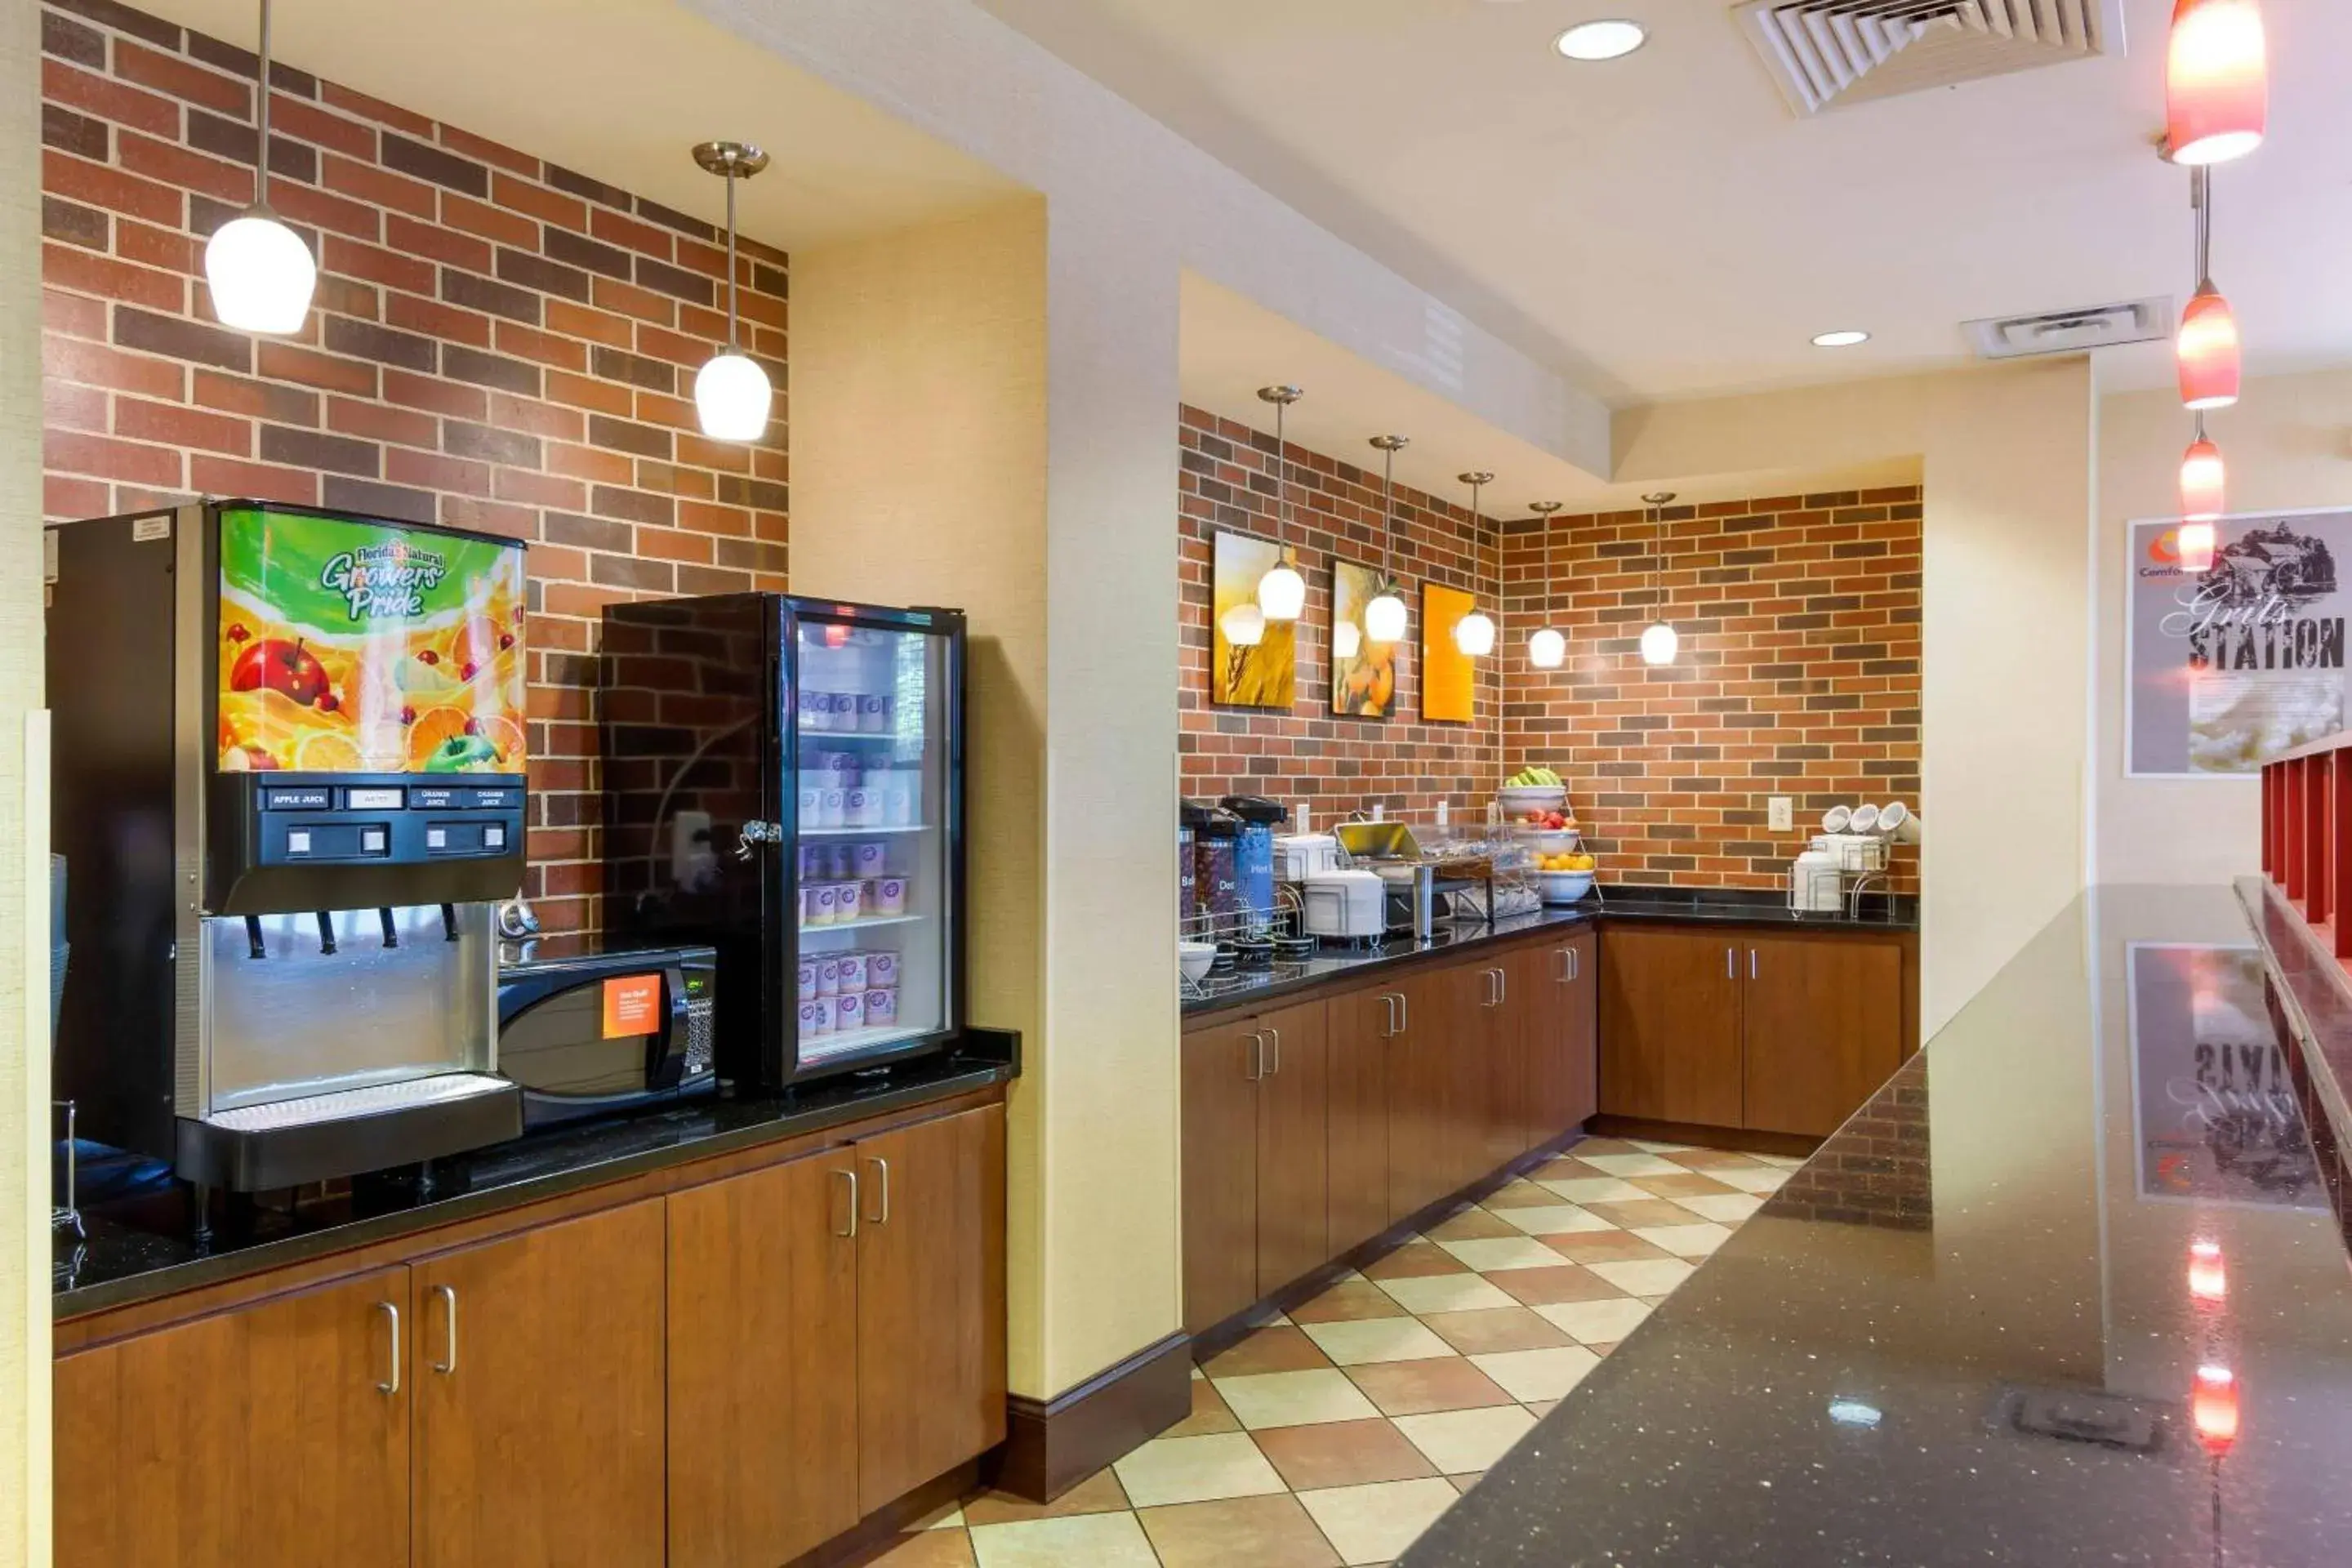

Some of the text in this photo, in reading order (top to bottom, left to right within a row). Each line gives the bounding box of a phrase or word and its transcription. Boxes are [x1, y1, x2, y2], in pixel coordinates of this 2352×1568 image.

[346, 586, 423, 621] Pride
[2158, 582, 2289, 638] Grits
[2188, 617, 2345, 671] STATION
[274, 795, 325, 804] APPLE JUICE
